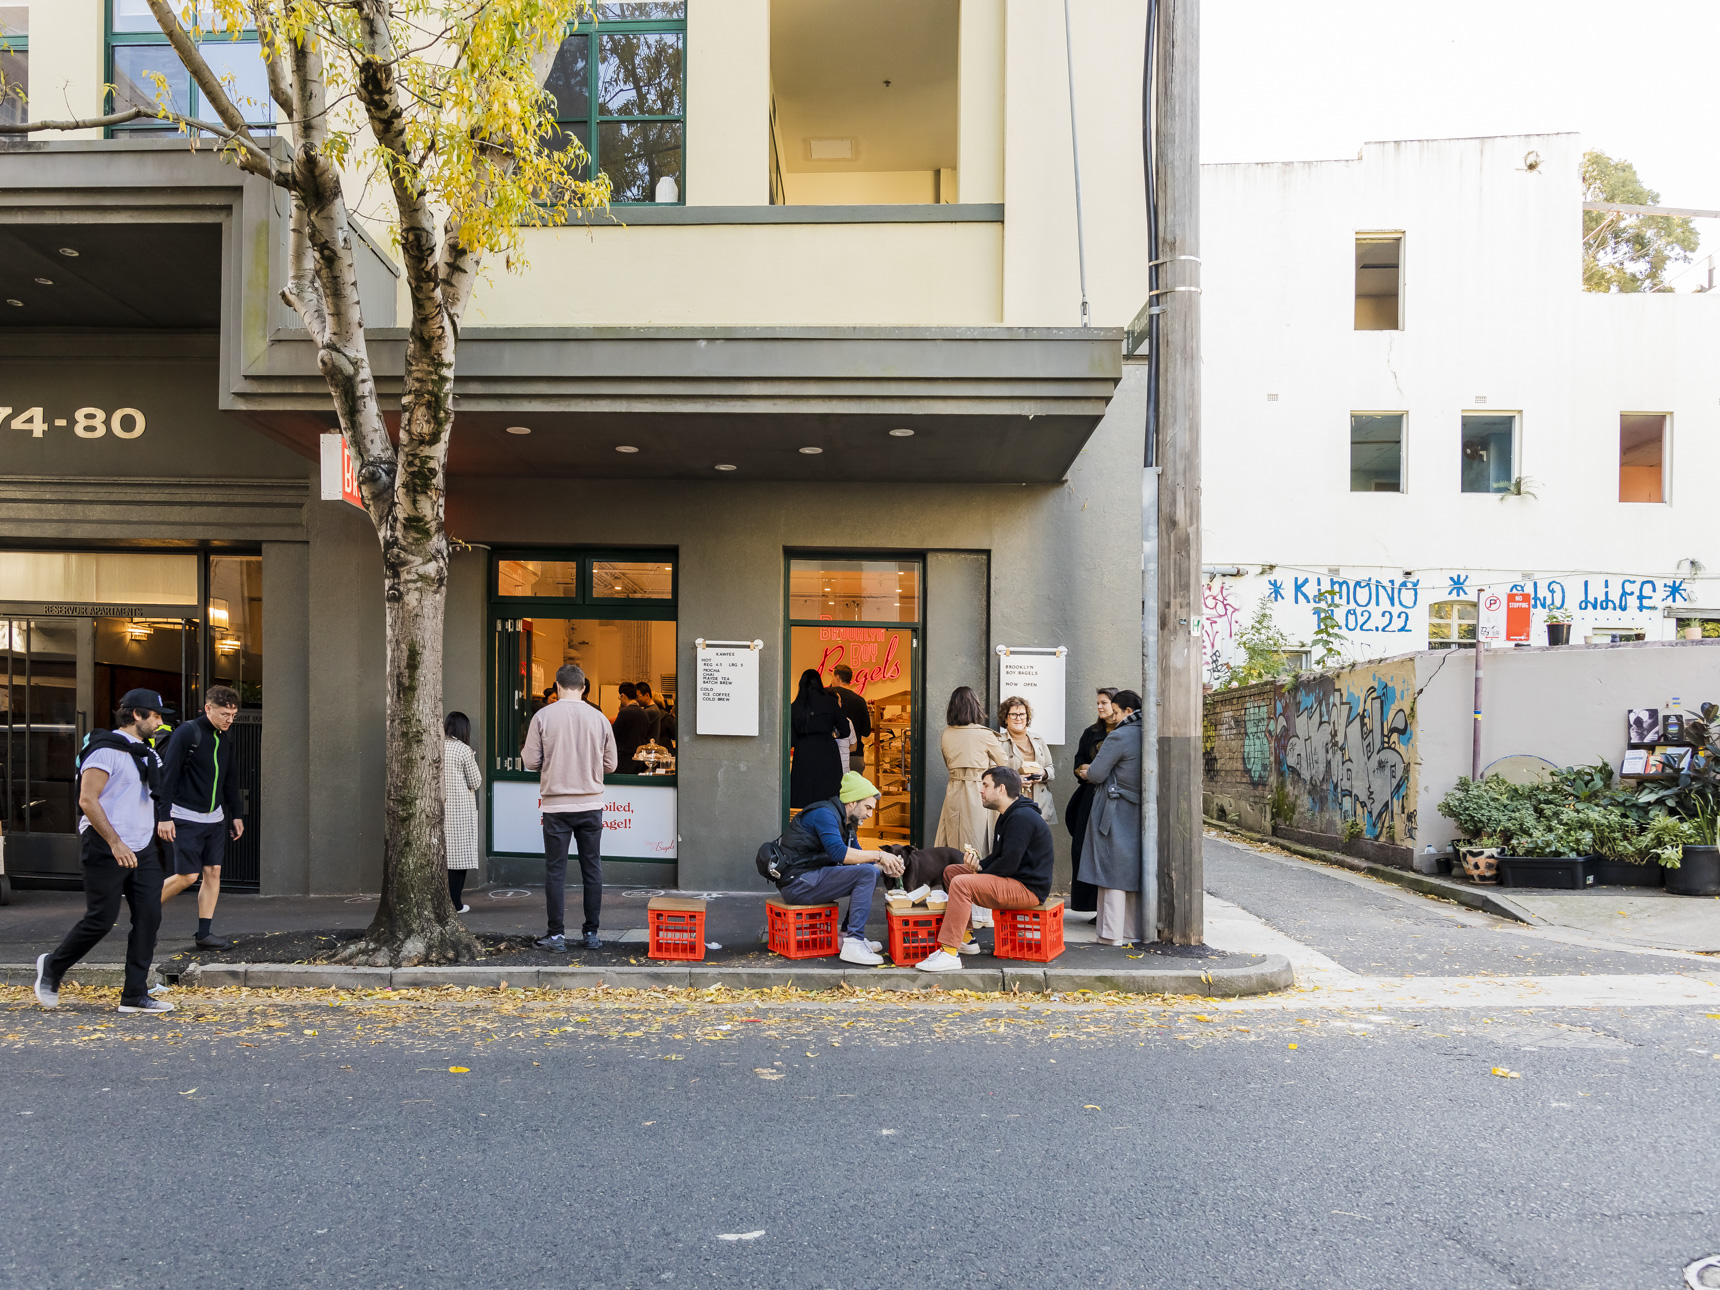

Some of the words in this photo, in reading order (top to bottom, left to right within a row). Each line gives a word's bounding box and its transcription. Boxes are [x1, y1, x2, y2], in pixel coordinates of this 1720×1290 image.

[90, 606, 143, 617] APARTMENTS
[850, 642, 878, 669] BOY
[817, 635, 901, 697] Bgels
[602, 801, 634, 814] oiled,
[602, 818, 632, 830] agel!
